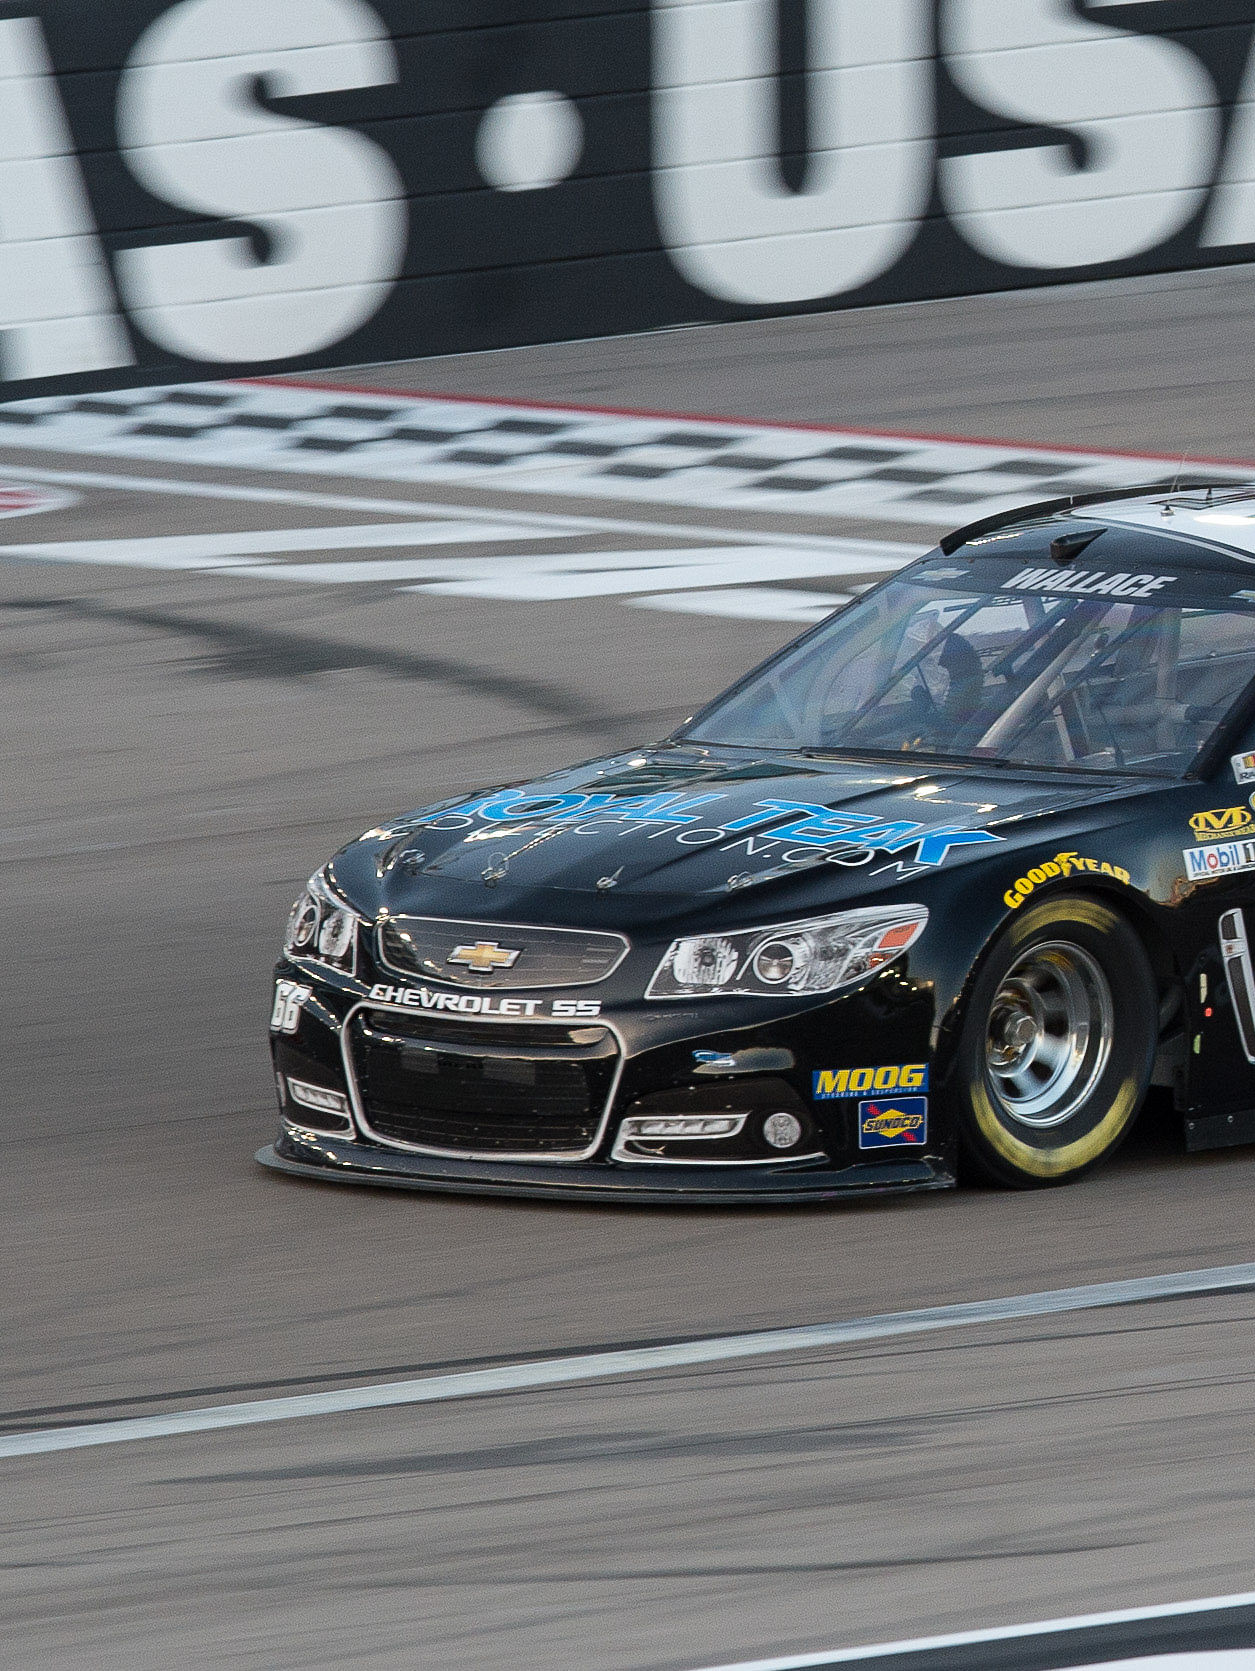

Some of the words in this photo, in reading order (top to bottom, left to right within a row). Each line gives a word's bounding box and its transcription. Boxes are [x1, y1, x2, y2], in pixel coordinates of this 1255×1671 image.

[1001, 568, 1177, 597] WALLACE
[718, 799, 1006, 866] TEAK
[1189, 844, 1240, 873] Mobil
[1003, 852, 1131, 909] GOODYEAR
[270, 979, 313, 1034] 66
[368, 985, 542, 1016] CHEVROLET
[551, 1000, 601, 1016] SS
[816, 1064, 926, 1094] MOOG
[862, 1114, 923, 1133] SUNOCO
